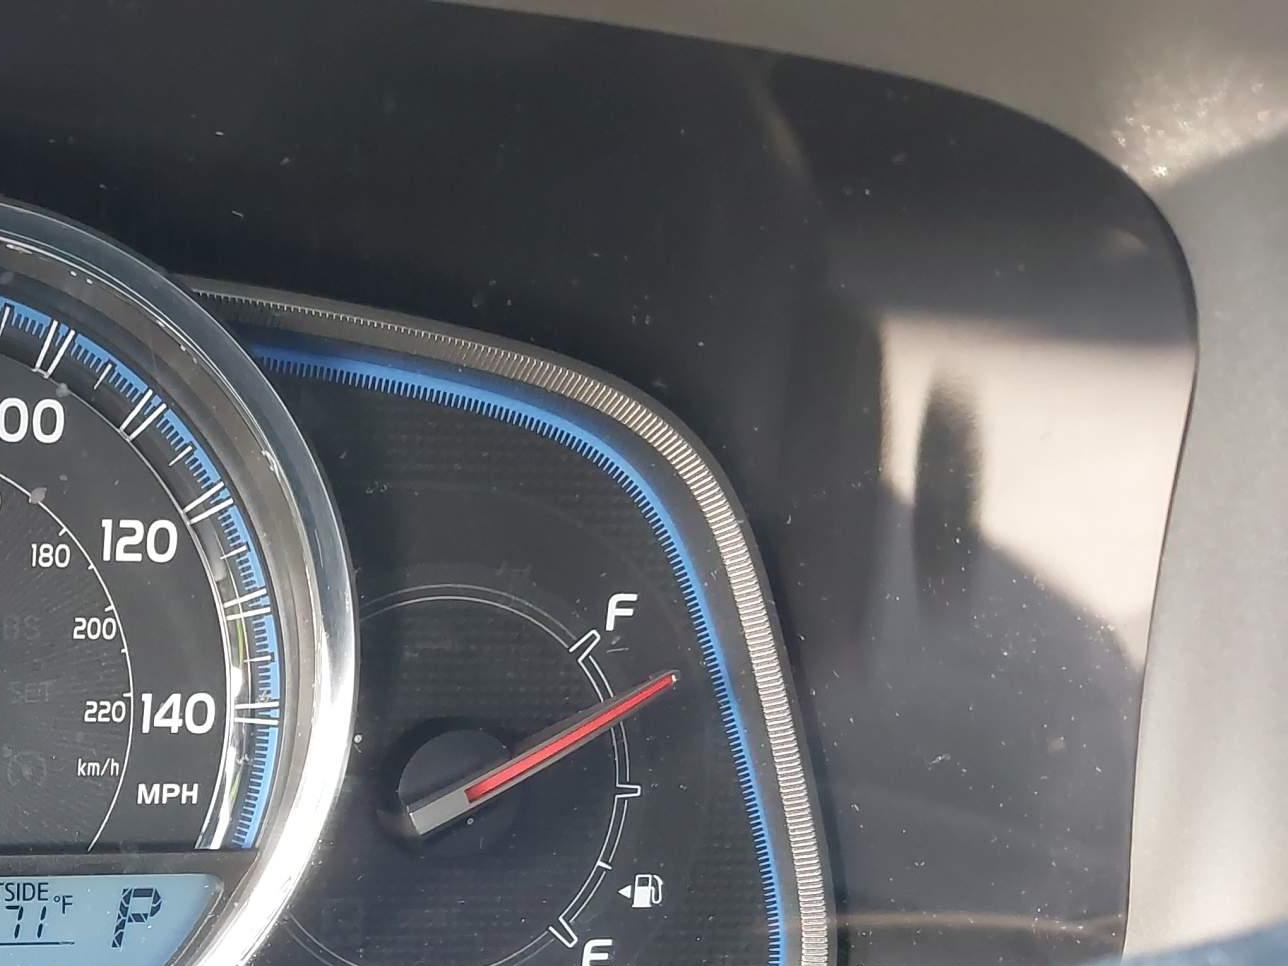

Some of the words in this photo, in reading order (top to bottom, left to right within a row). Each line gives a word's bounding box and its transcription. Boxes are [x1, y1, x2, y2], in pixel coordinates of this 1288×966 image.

[31, 543, 71, 568] 180
[101, 518, 178, 563] 120
[73, 611, 119, 640] 200
[605, 593, 638, 632] F
[84, 700, 126, 723] 220
[141, 692, 216, 734] 140
[77, 758, 120, 777] km/h
[137, 783, 199, 805] MPH
[10, 905, 48, 940] 71
[111, 887, 162, 948] P
